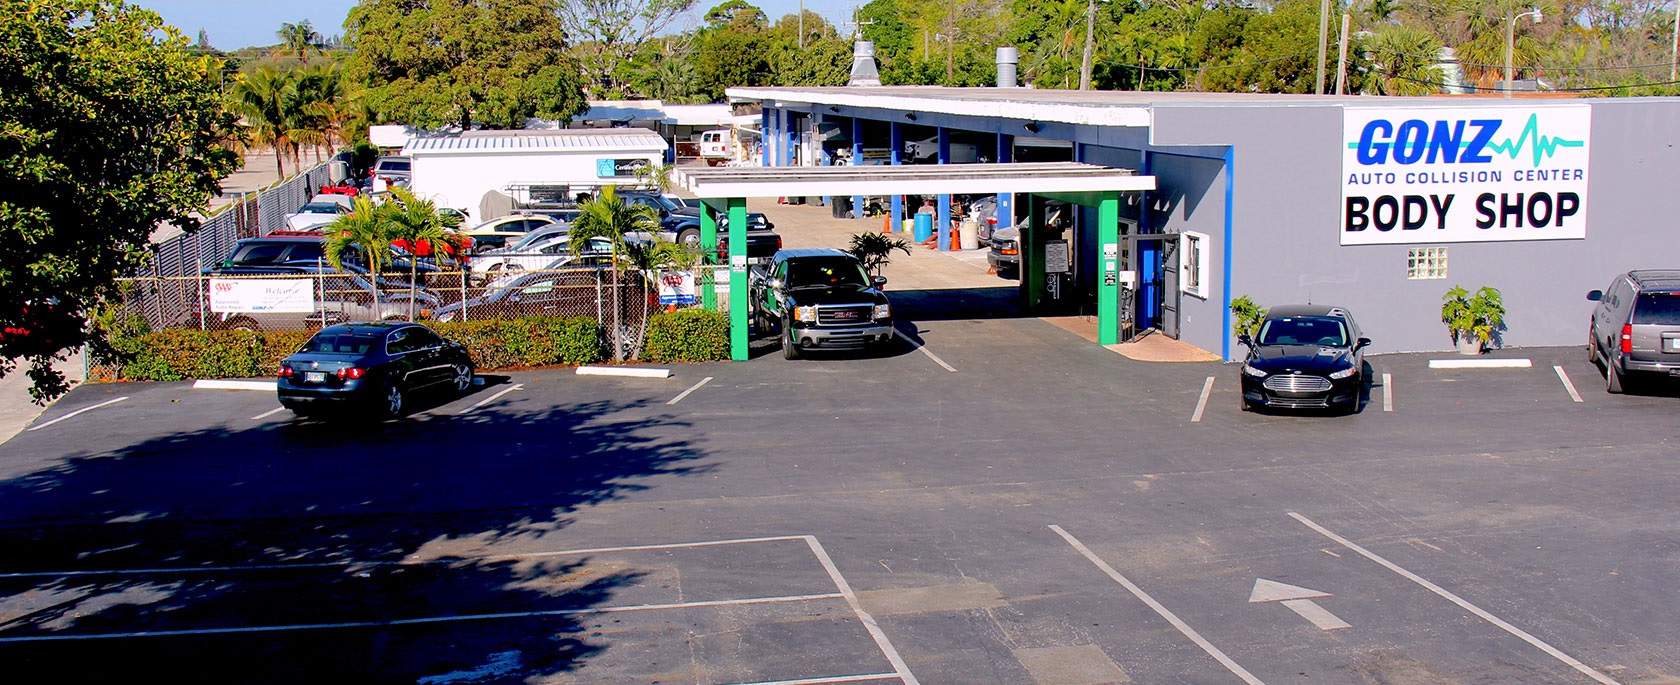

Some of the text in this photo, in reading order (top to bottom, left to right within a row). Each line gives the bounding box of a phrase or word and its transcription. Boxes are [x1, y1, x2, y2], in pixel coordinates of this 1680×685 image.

[1357, 119, 1502, 165] GONZ
[1348, 169, 1583, 185] AUTO COLLISION CENTER
[1345, 192, 1580, 232] BODY SHOP
